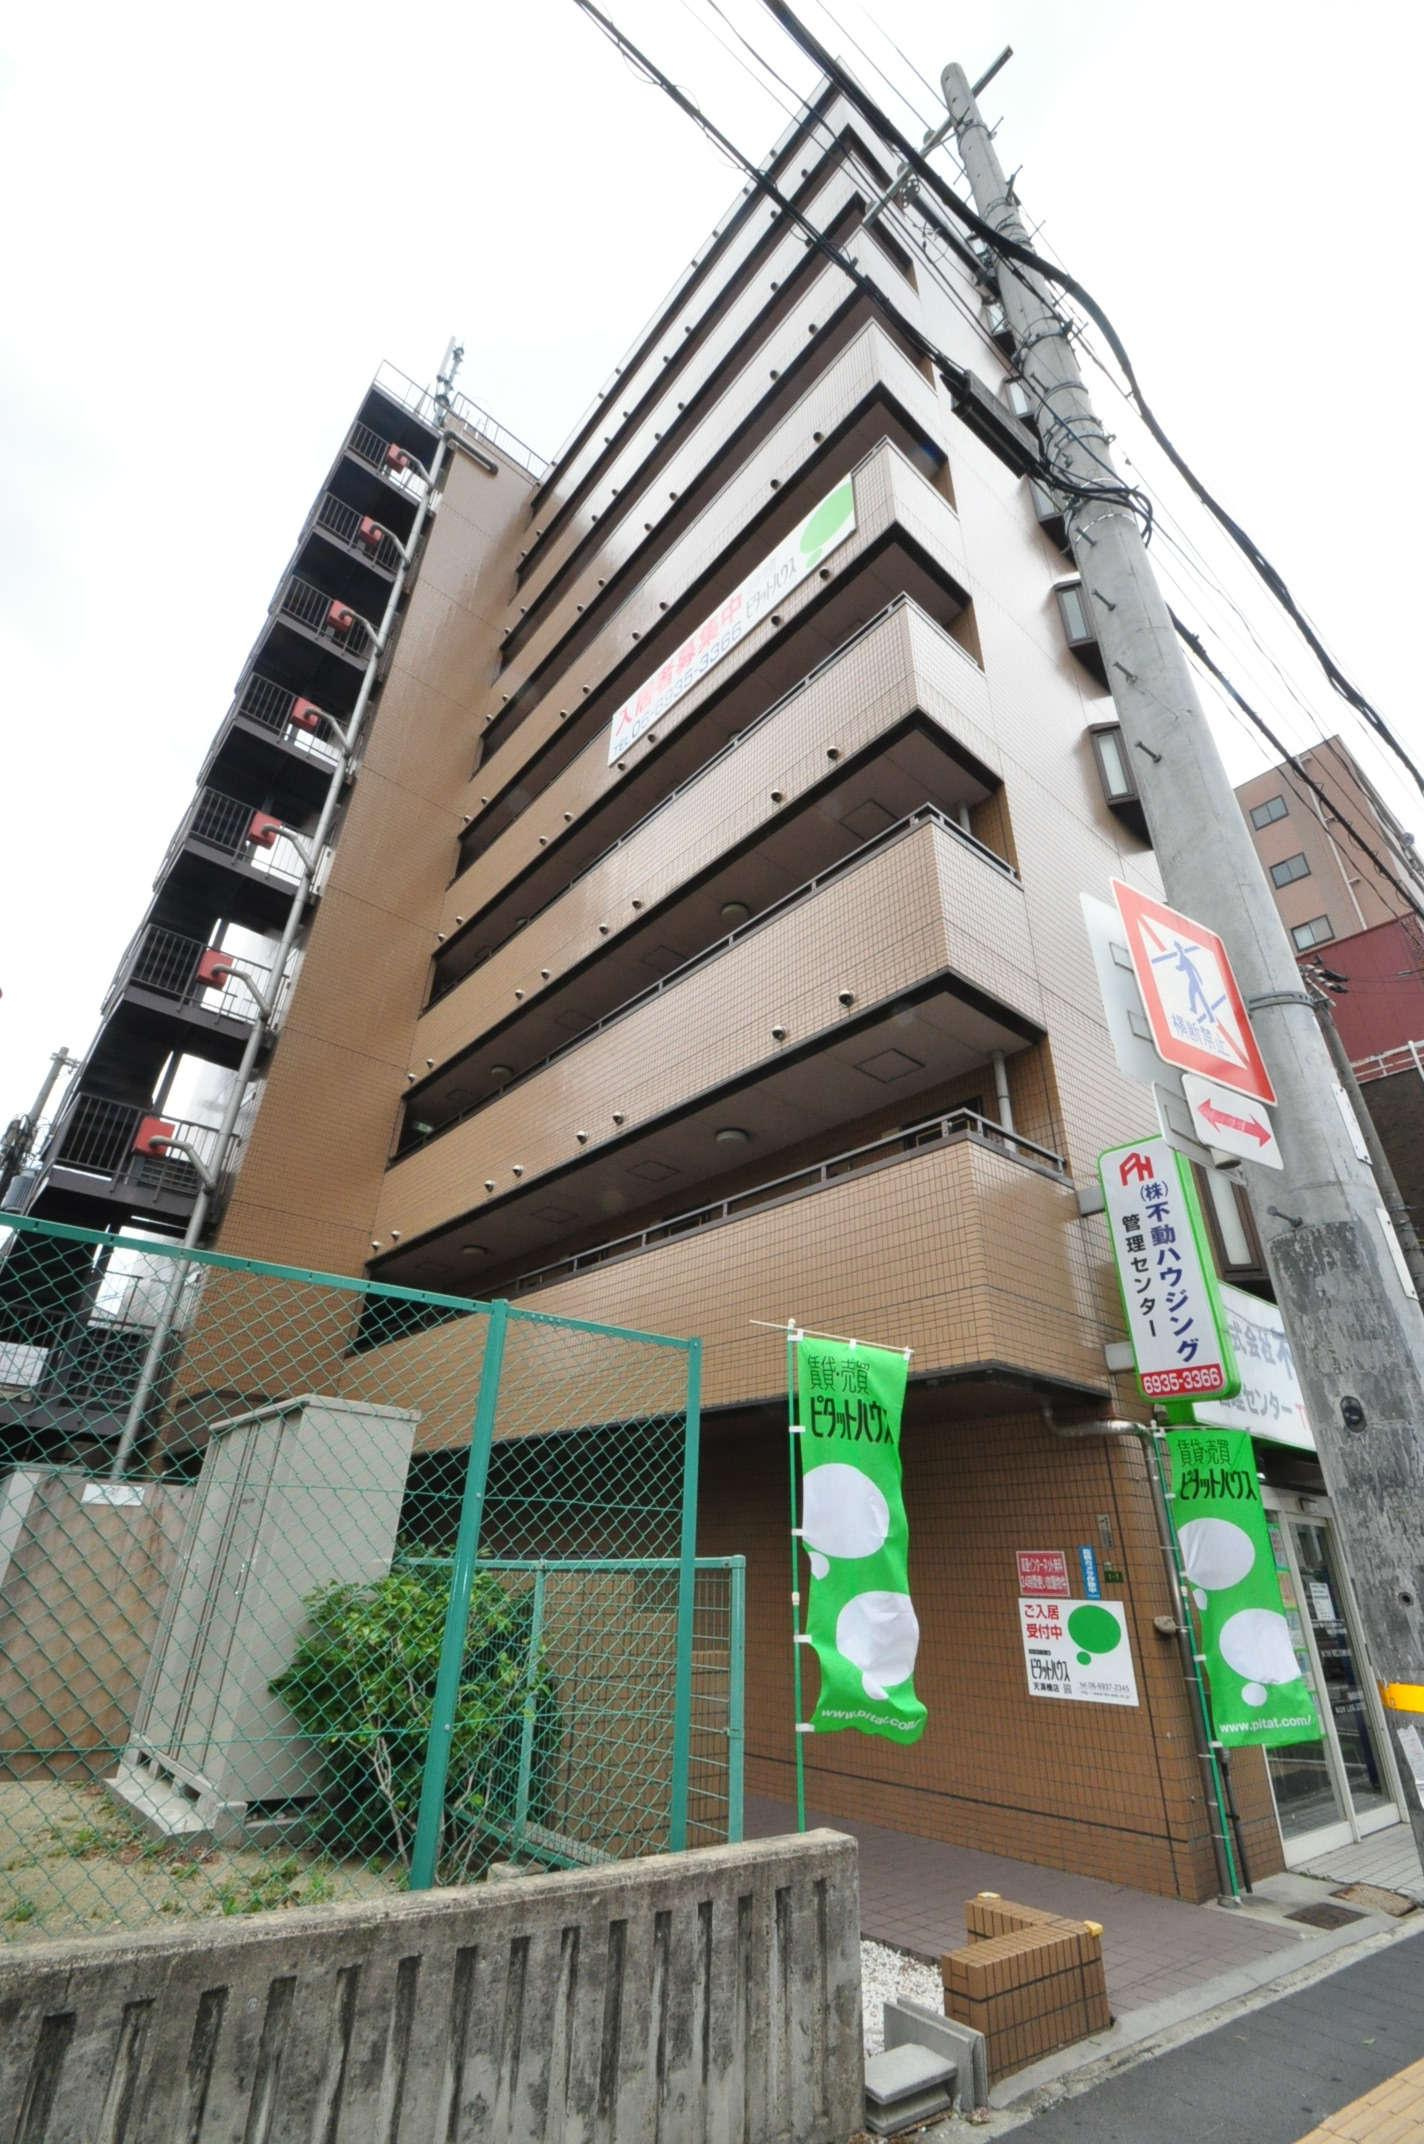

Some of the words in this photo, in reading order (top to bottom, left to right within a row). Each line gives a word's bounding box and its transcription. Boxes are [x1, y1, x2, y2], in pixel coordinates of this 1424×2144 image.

[1122, 1213, 1157, 1338] 管理センター
[807, 1354, 870, 1396] 賃貸・売買
[1142, 1367, 1222, 1394] 6935-3366
[810, 1395, 895, 1445] ピタットハウス
[1177, 1438, 1231, 1468] 賃貸・売買
[1180, 1468, 1258, 1502] ピタットハウス
[1024, 1604, 1060, 1621] ご入居
[1026, 1624, 1063, 1641] 受付中
[1030, 1658, 1071, 1683] ピタットハウス
[1219, 1714, 1312, 1735] www.pitat.com/
